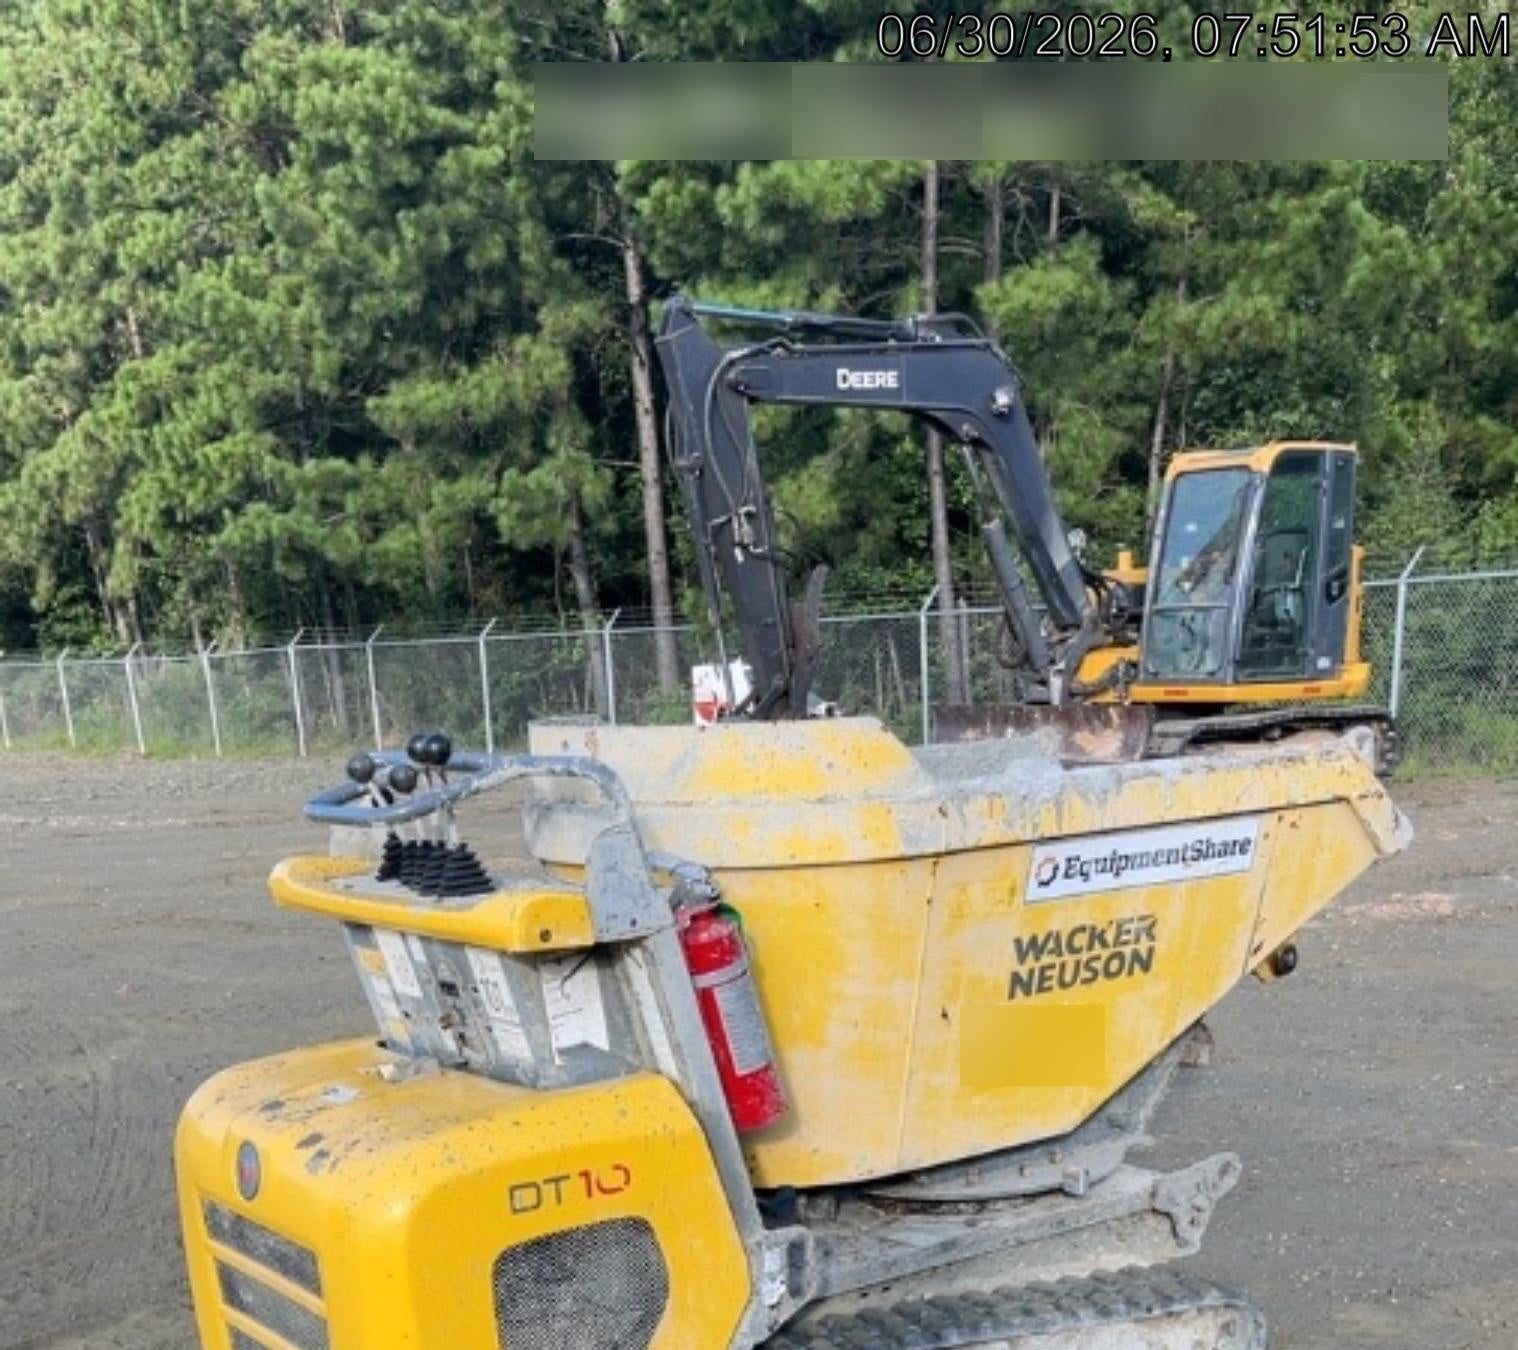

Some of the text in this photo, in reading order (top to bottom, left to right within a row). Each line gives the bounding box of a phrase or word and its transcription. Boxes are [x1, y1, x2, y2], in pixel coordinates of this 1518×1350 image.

[836, 368, 899, 390] DEERE
[1062, 836, 1252, 882] EquipmentShare
[1013, 915, 1158, 966] WACKER
[1007, 946, 1155, 1000] NEUSON
